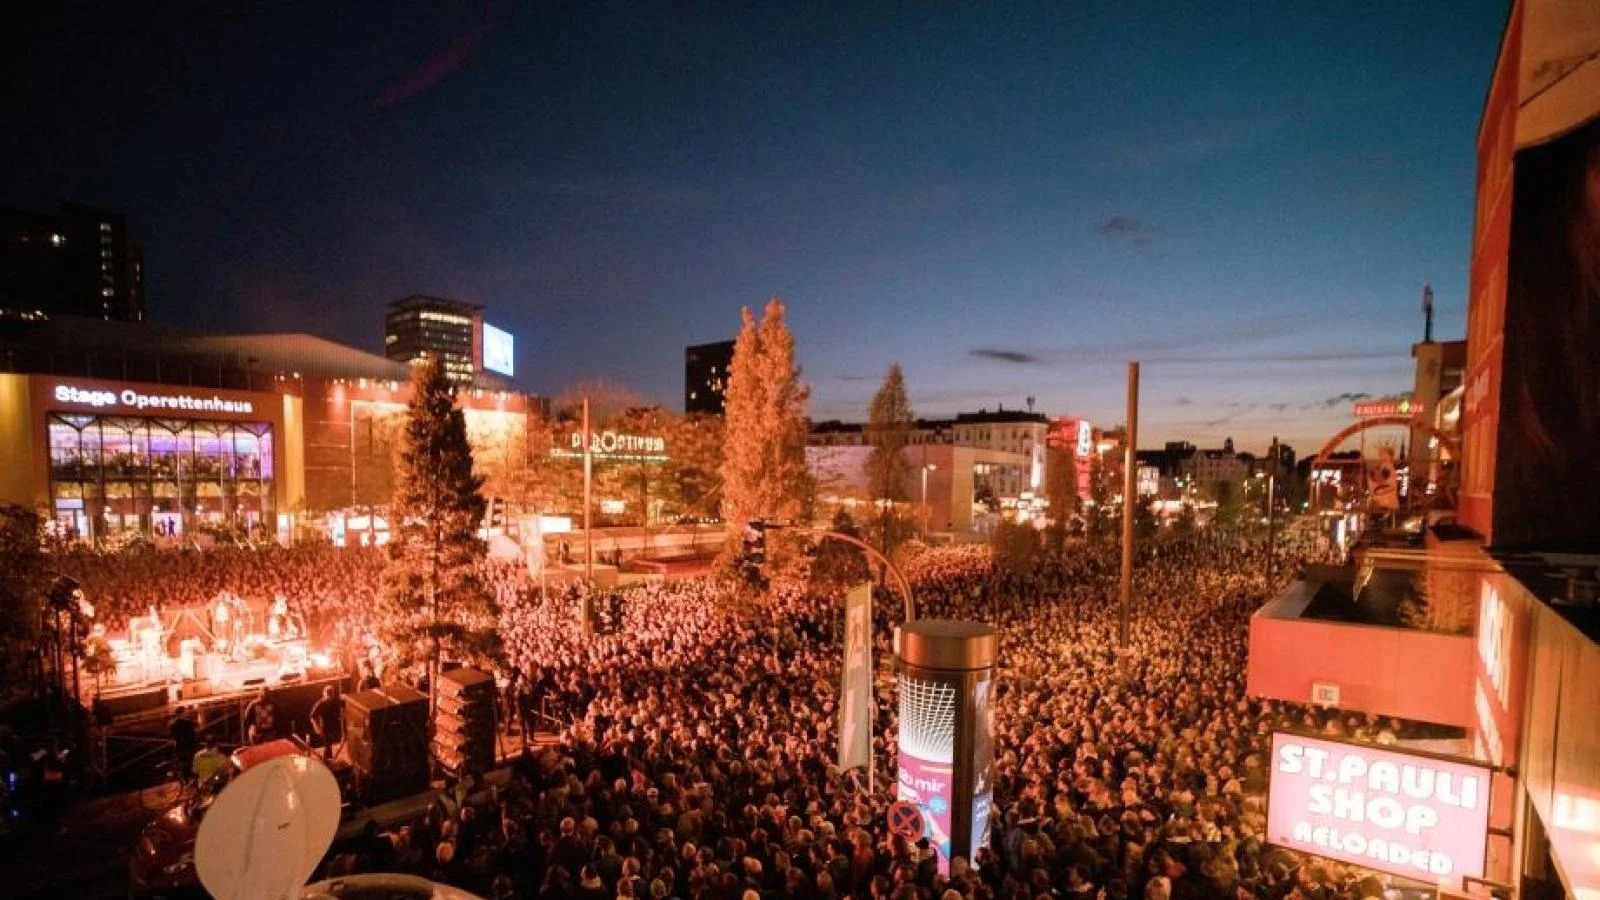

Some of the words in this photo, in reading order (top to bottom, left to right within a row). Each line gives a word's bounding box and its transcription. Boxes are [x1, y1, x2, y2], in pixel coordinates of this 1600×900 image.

[55, 385, 116, 407] Stage
[121, 389, 253, 413] Operettenhaus
[1307, 783, 1439, 836] SHOP
[1294, 821, 1454, 876] RELOADED
